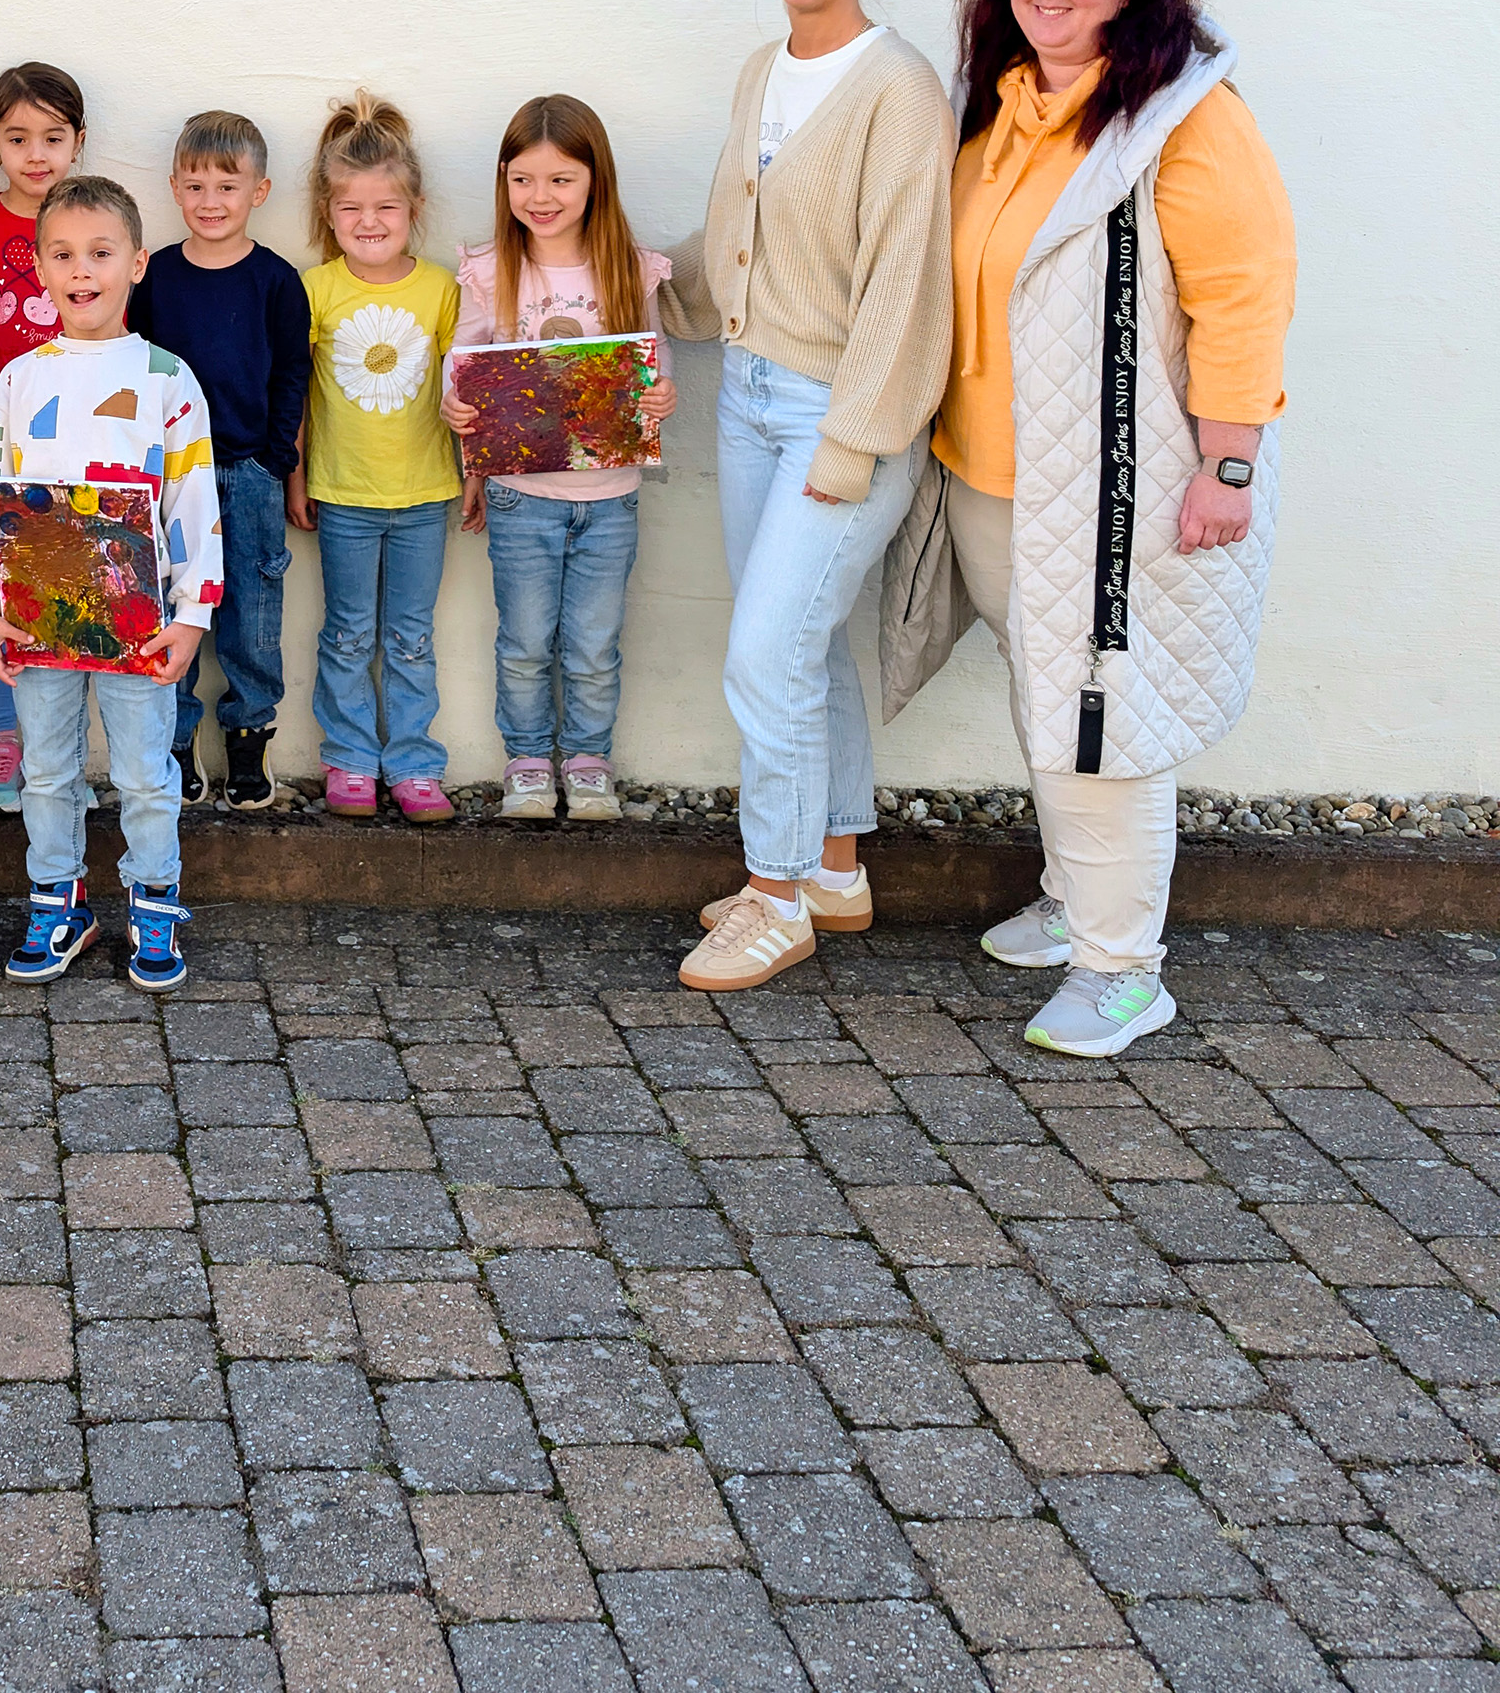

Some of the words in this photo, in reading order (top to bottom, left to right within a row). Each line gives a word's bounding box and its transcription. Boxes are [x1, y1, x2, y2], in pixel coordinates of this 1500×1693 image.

[1119, 232, 1132, 282] ENJOY
[1113, 287, 1136, 329] Stories
[22, 328, 56, 344] Smil
[1114, 330, 1136, 366] Soccx
[1115, 368, 1129, 418] ENJOY
[1110, 422, 1134, 465] Stories
[1111, 466, 1133, 502] Soccx
[1111, 504, 1125, 553] ENJOY
[1105, 558, 1126, 599] Stories
[1105, 600, 1126, 635] Soccx
